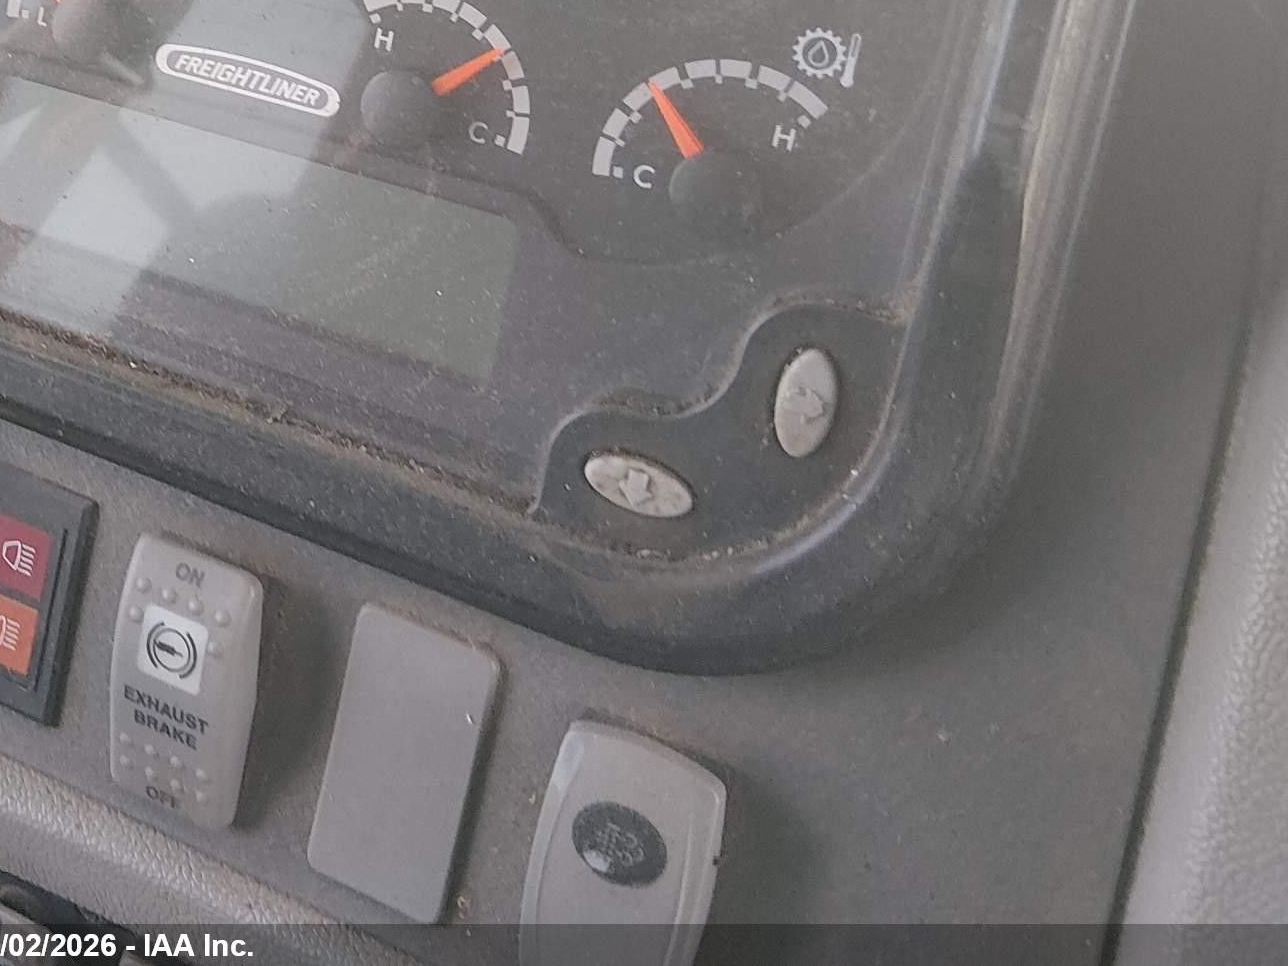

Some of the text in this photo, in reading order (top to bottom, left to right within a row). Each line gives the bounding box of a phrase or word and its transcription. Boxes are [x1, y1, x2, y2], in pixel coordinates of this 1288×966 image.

[37, 6, 47, 27] L
[374, 28, 394, 52] H
[175, 54, 321, 105] FREIGHTLINER
[467, 120, 488, 146] C
[771, 125, 796, 152] H
[632, 163, 656, 189] C
[175, 561, 205, 586] ON
[123, 684, 209, 734] EXHAUST
[134, 708, 197, 750] BRAKE
[145, 785, 180, 810] OFF
